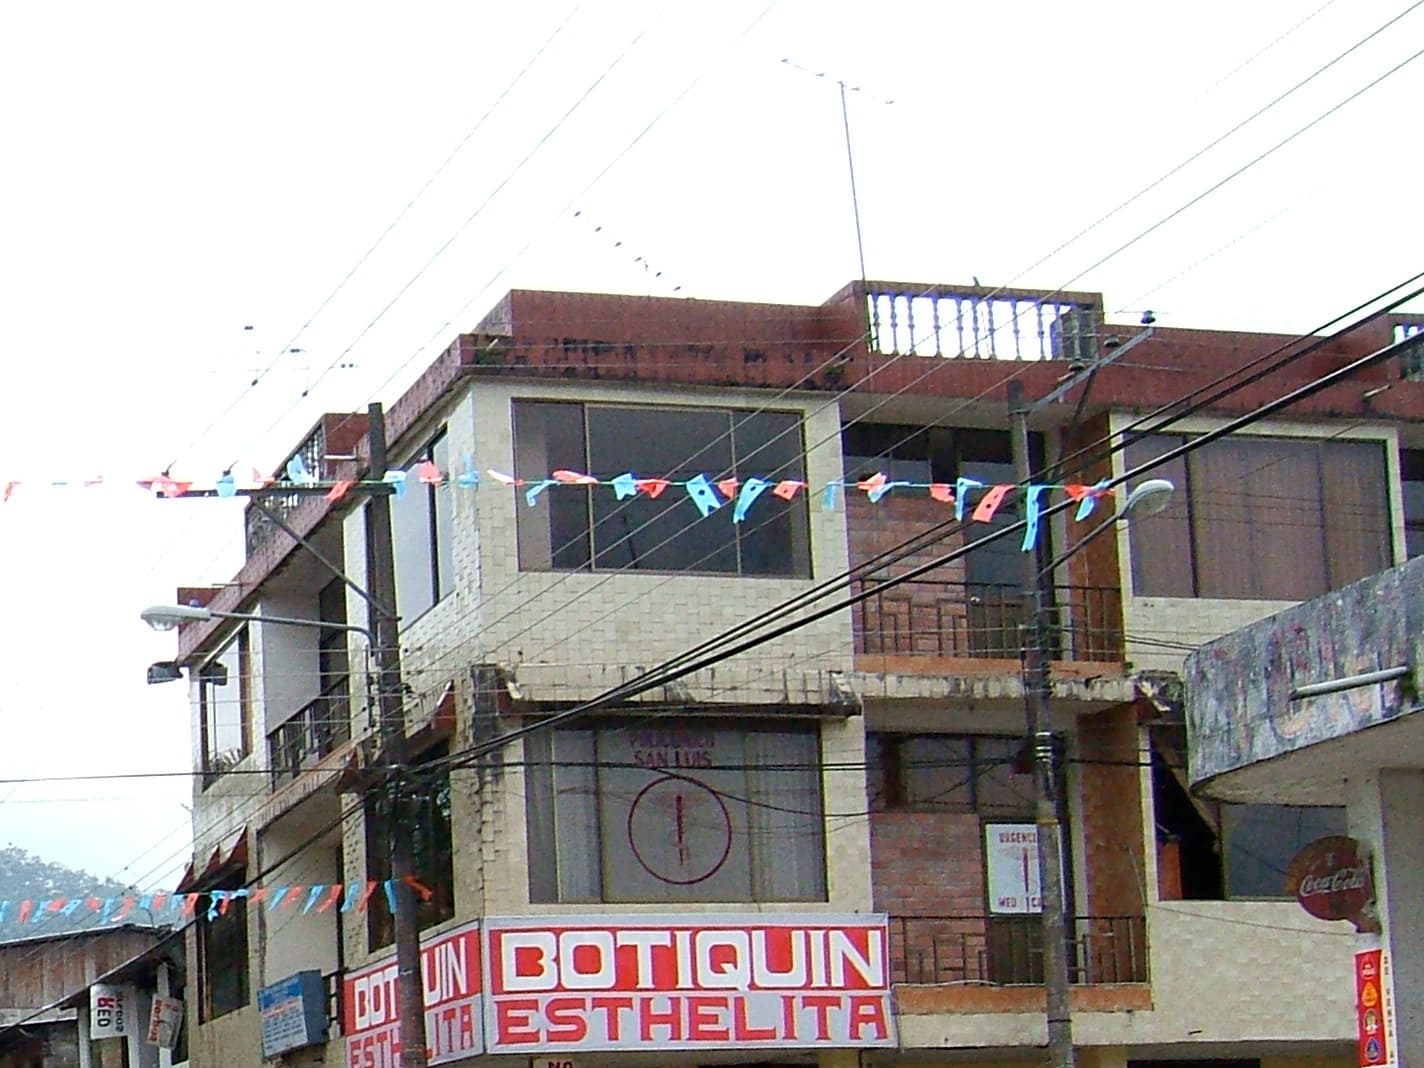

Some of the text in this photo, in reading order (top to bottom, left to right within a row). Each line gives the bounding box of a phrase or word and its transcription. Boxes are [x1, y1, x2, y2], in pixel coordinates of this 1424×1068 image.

[354, 936, 468, 1031] BOTUIN
[499, 928, 886, 992] BOTIQUIN
[493, 994, 889, 1046] ESTHELITA
